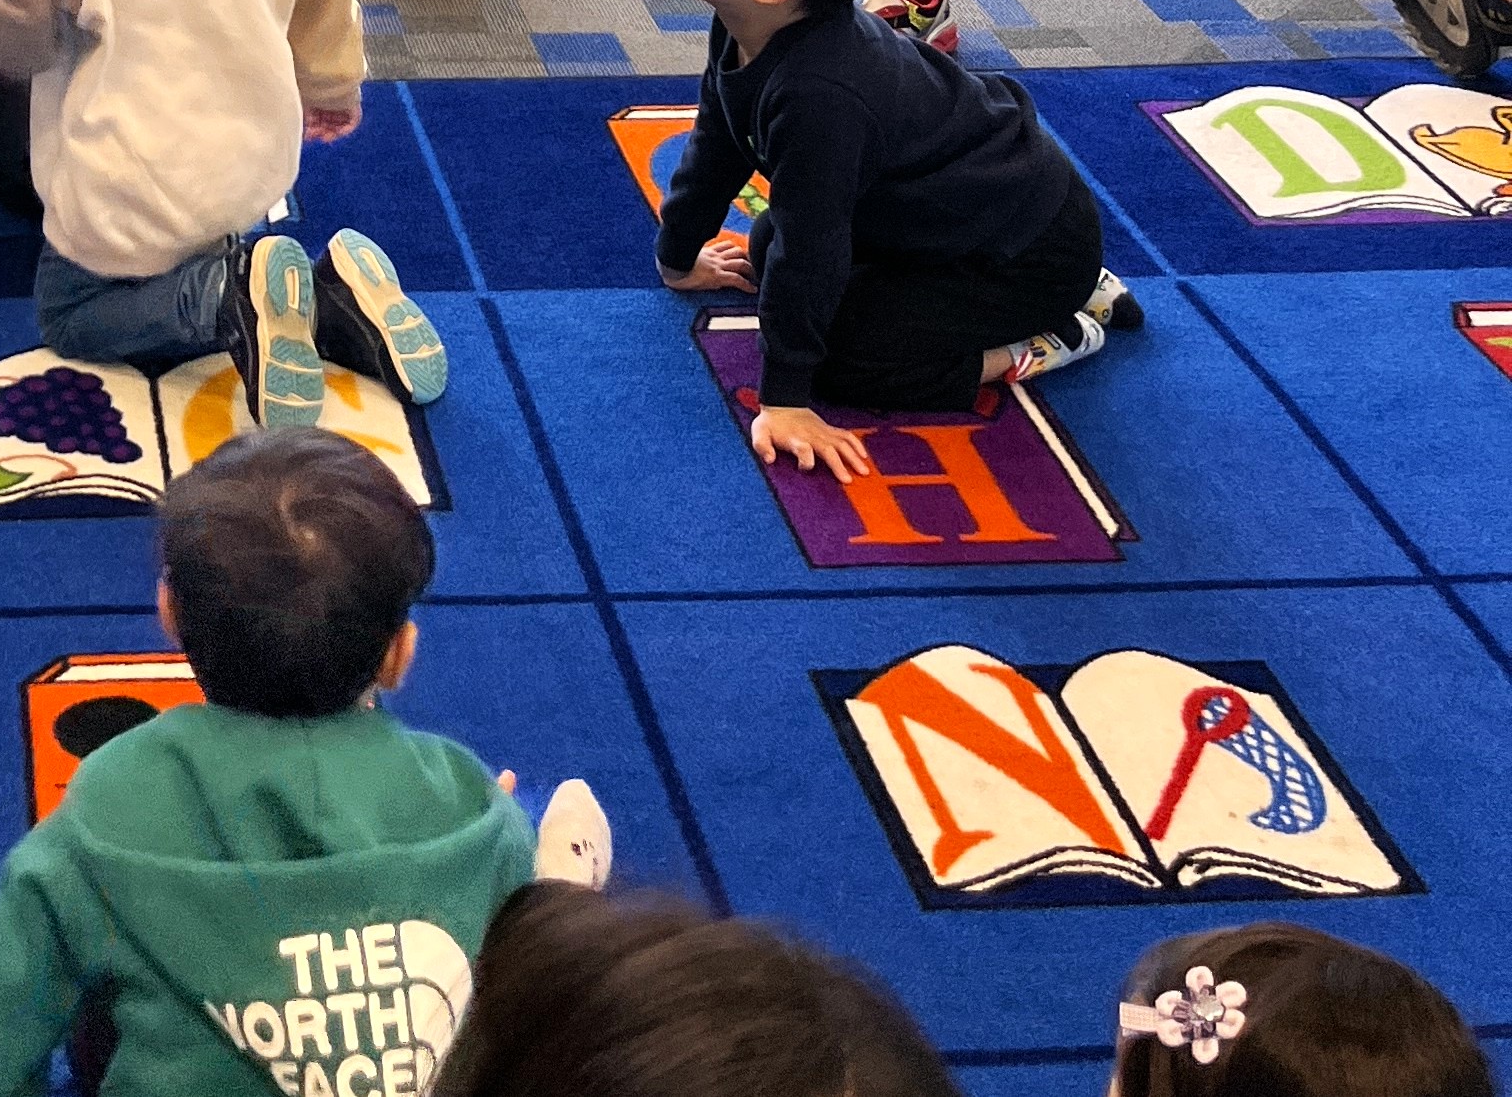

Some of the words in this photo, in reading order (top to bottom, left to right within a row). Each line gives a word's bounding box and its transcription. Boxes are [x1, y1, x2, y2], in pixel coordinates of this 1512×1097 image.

[1211, 99, 1408, 198] D
[844, 424, 1058, 545] H
[856, 658, 1128, 877] N
[278, 922, 404, 994] THE
